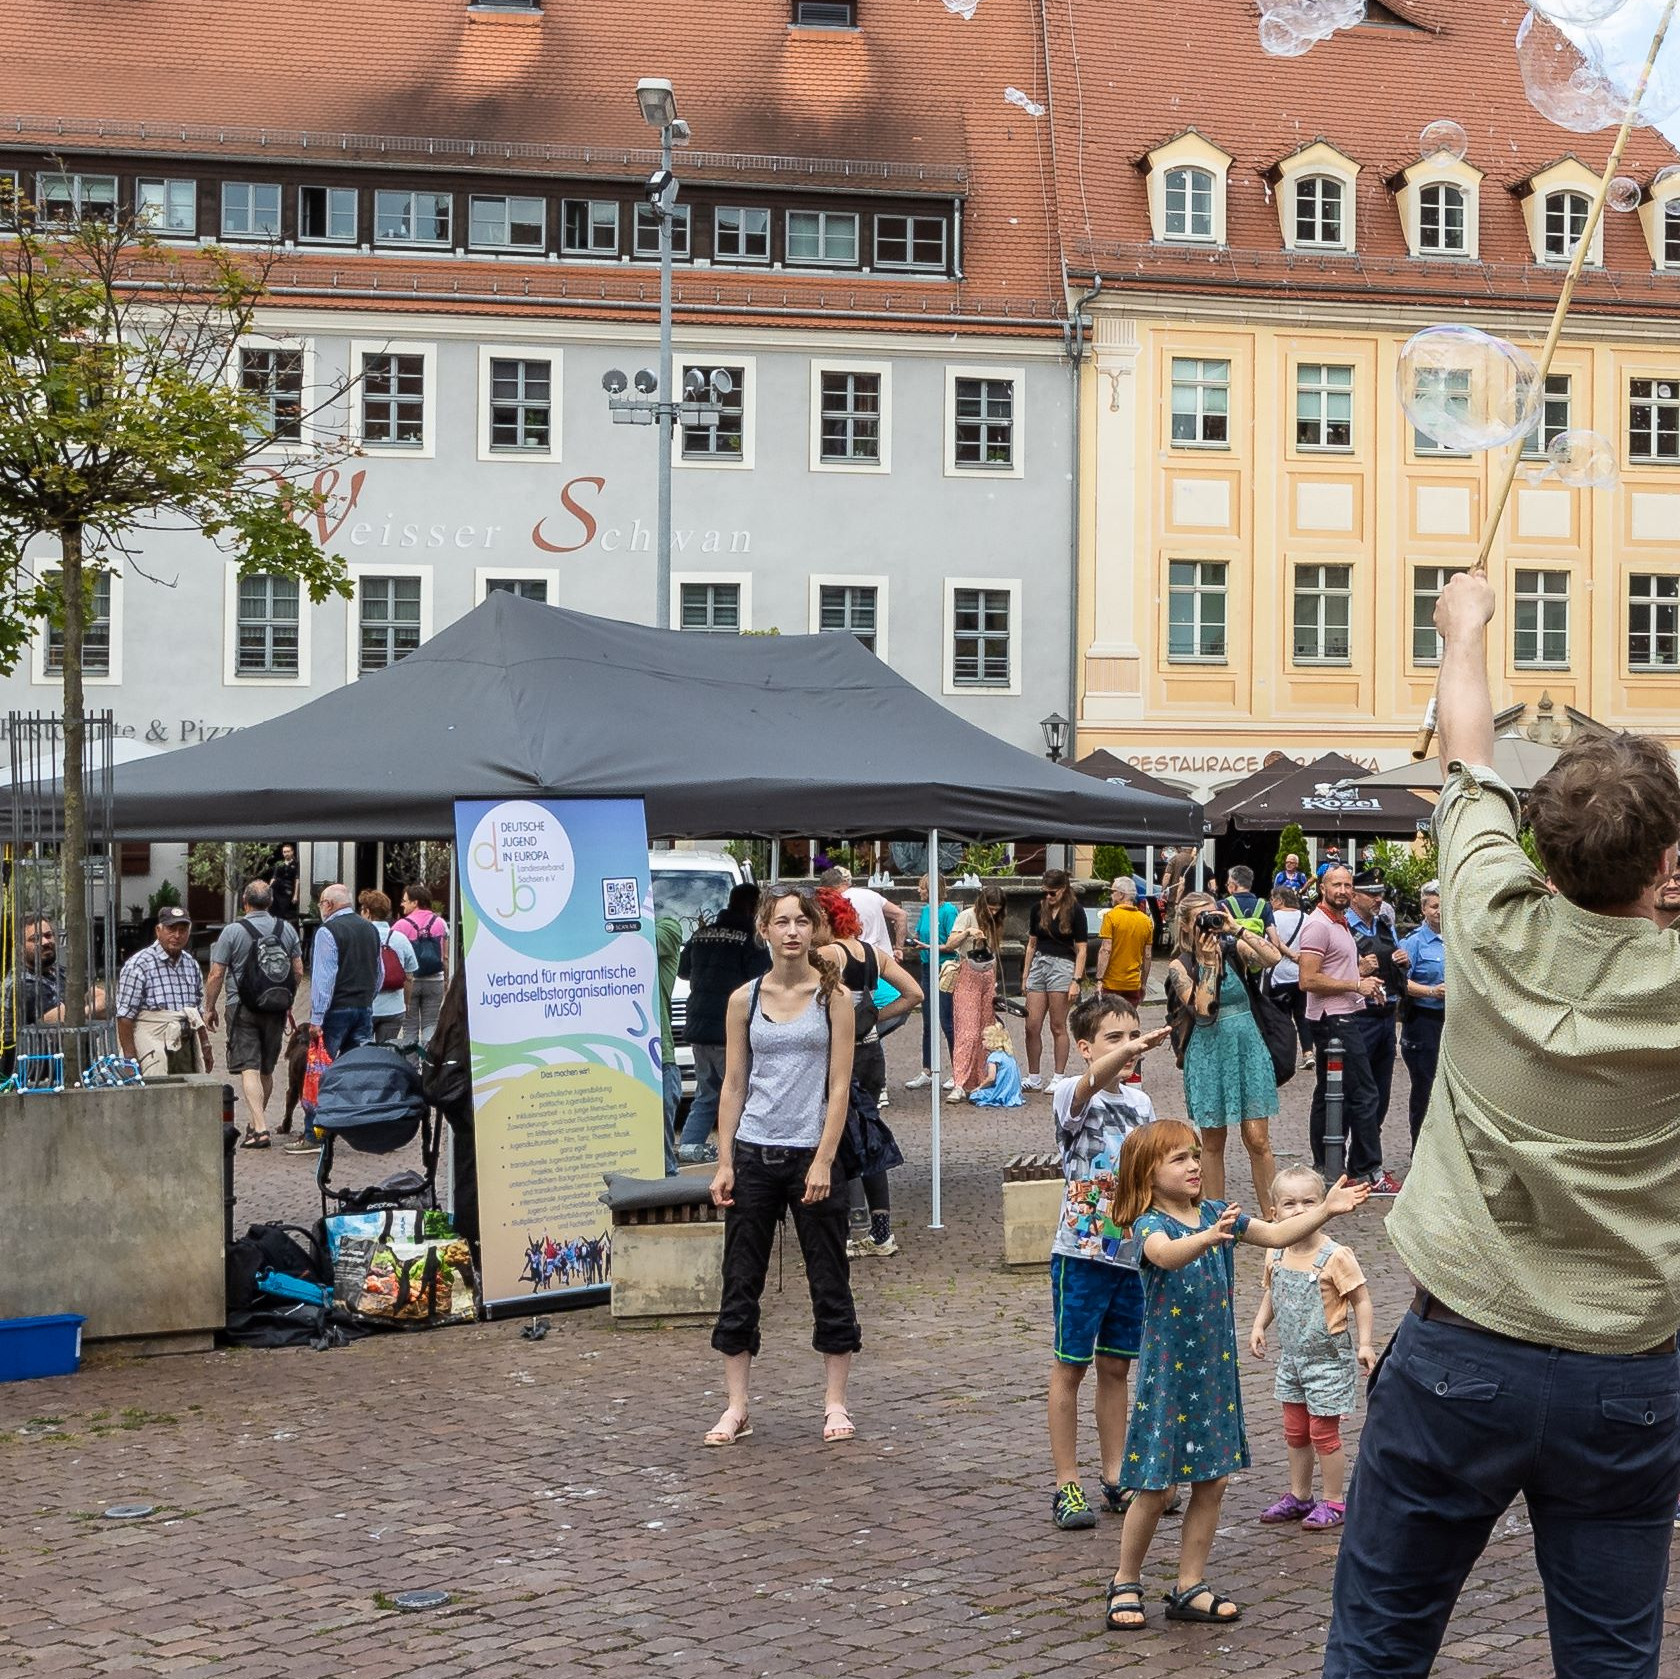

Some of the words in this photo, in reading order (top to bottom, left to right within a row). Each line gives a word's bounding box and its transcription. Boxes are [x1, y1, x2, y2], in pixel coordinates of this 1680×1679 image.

[532, 475, 752, 553] Schwan
[145, 718, 169, 742] &
[1128, 756, 1259, 773] RESTAURACE
[1300, 797, 1383, 811] Kozel
[501, 821, 545, 832] DEUTSCHE
[502, 836, 537, 847] JUGEND
[503, 852, 512, 862] IN
[514, 851, 550, 862] EUROPA
[517, 863, 565, 873] Landesverband
[518, 874, 545, 883] Sachsen
[487, 969, 538, 987] Verband
[541, 968, 556, 984] für
[559, 964, 636, 985] migrantische
[480, 982, 645, 1008] Jugendselbstorganisationen
[544, 1002, 582, 1019] (MJSO)
[540, 1071, 553, 1079] Das
[554, 1069, 578, 1078] machen
